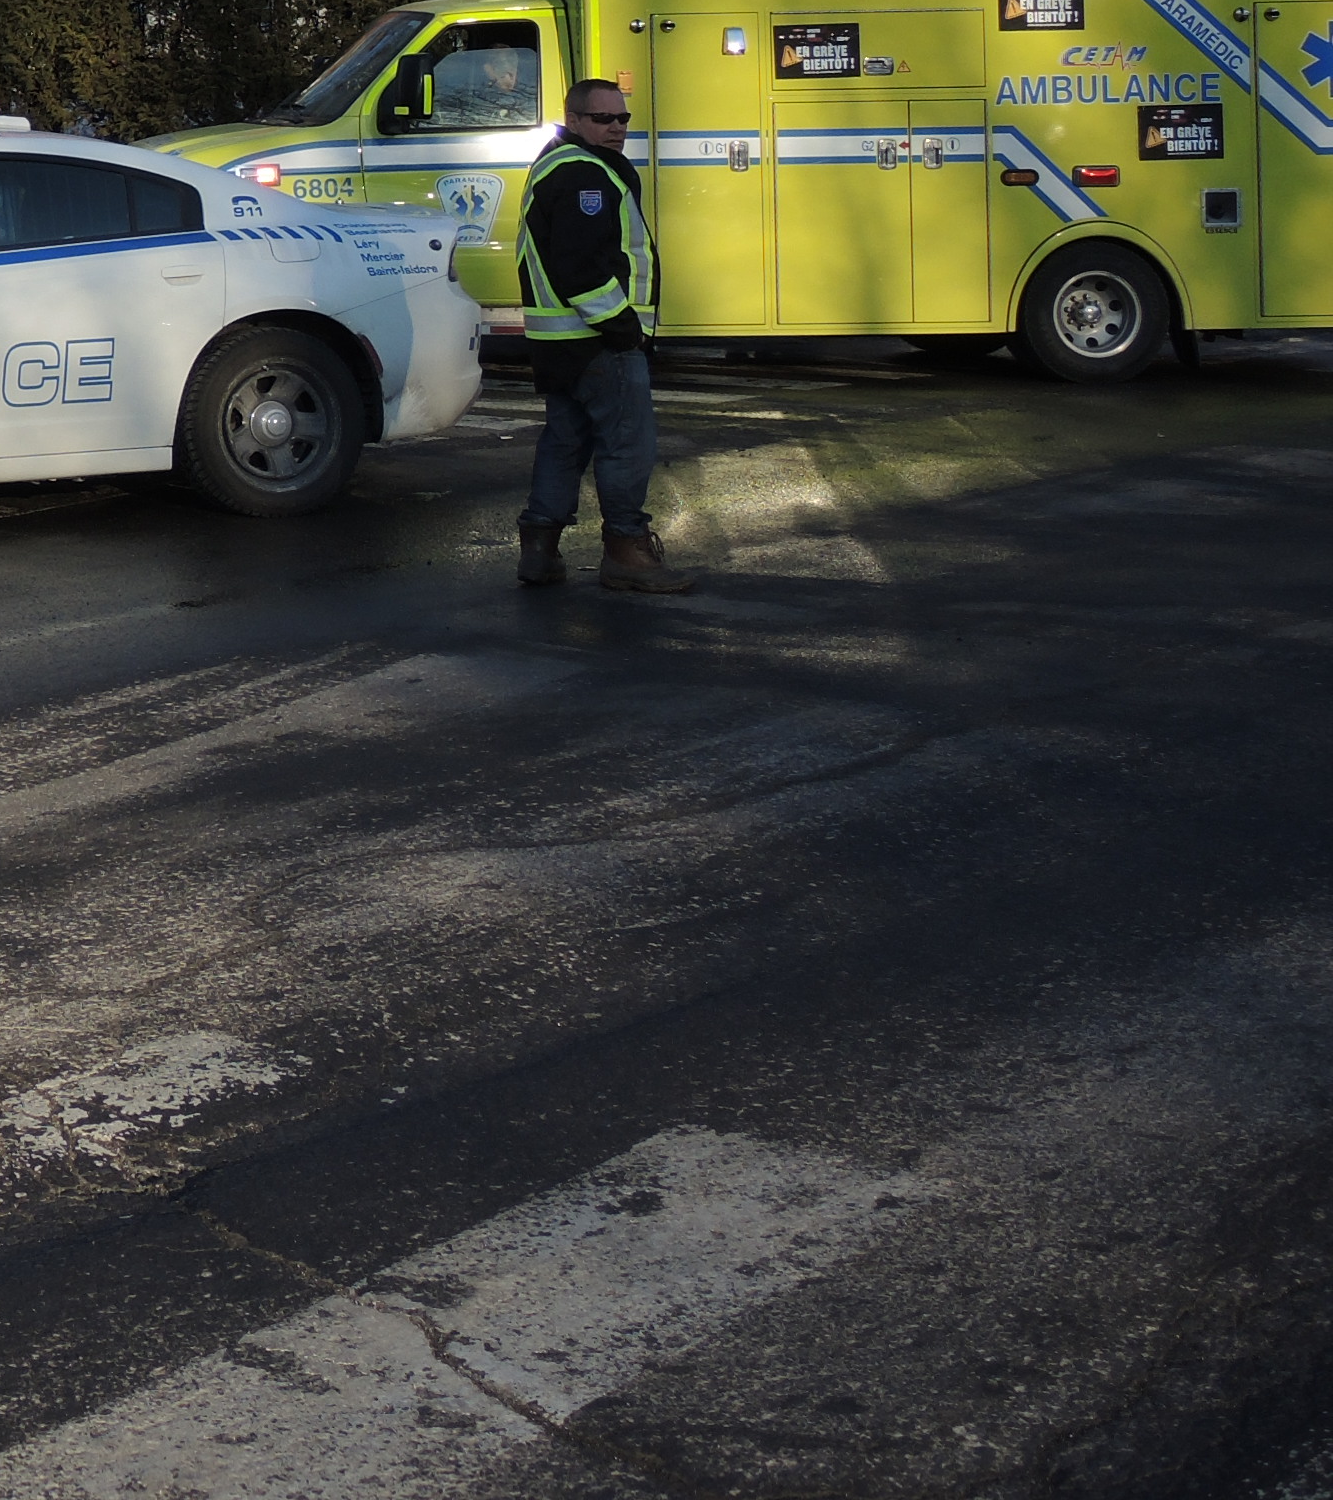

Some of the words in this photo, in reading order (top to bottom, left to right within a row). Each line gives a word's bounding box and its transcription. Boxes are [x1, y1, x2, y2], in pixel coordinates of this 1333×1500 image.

[795, 45, 810, 58] EN
[1061, 41, 1147, 69] CETAM
[995, 73, 1221, 106] AMBULANCE
[1159, 126, 1174, 139] EN
[715, 143, 728, 154] G1
[861, 140, 875, 152] G2
[292, 177, 355, 199] 6804
[233, 206, 264, 218] 911
[354, 239, 380, 250] Léry
[360, 251, 406, 262] Mercier
[367, 263, 439, 277] Saint-Isidore
